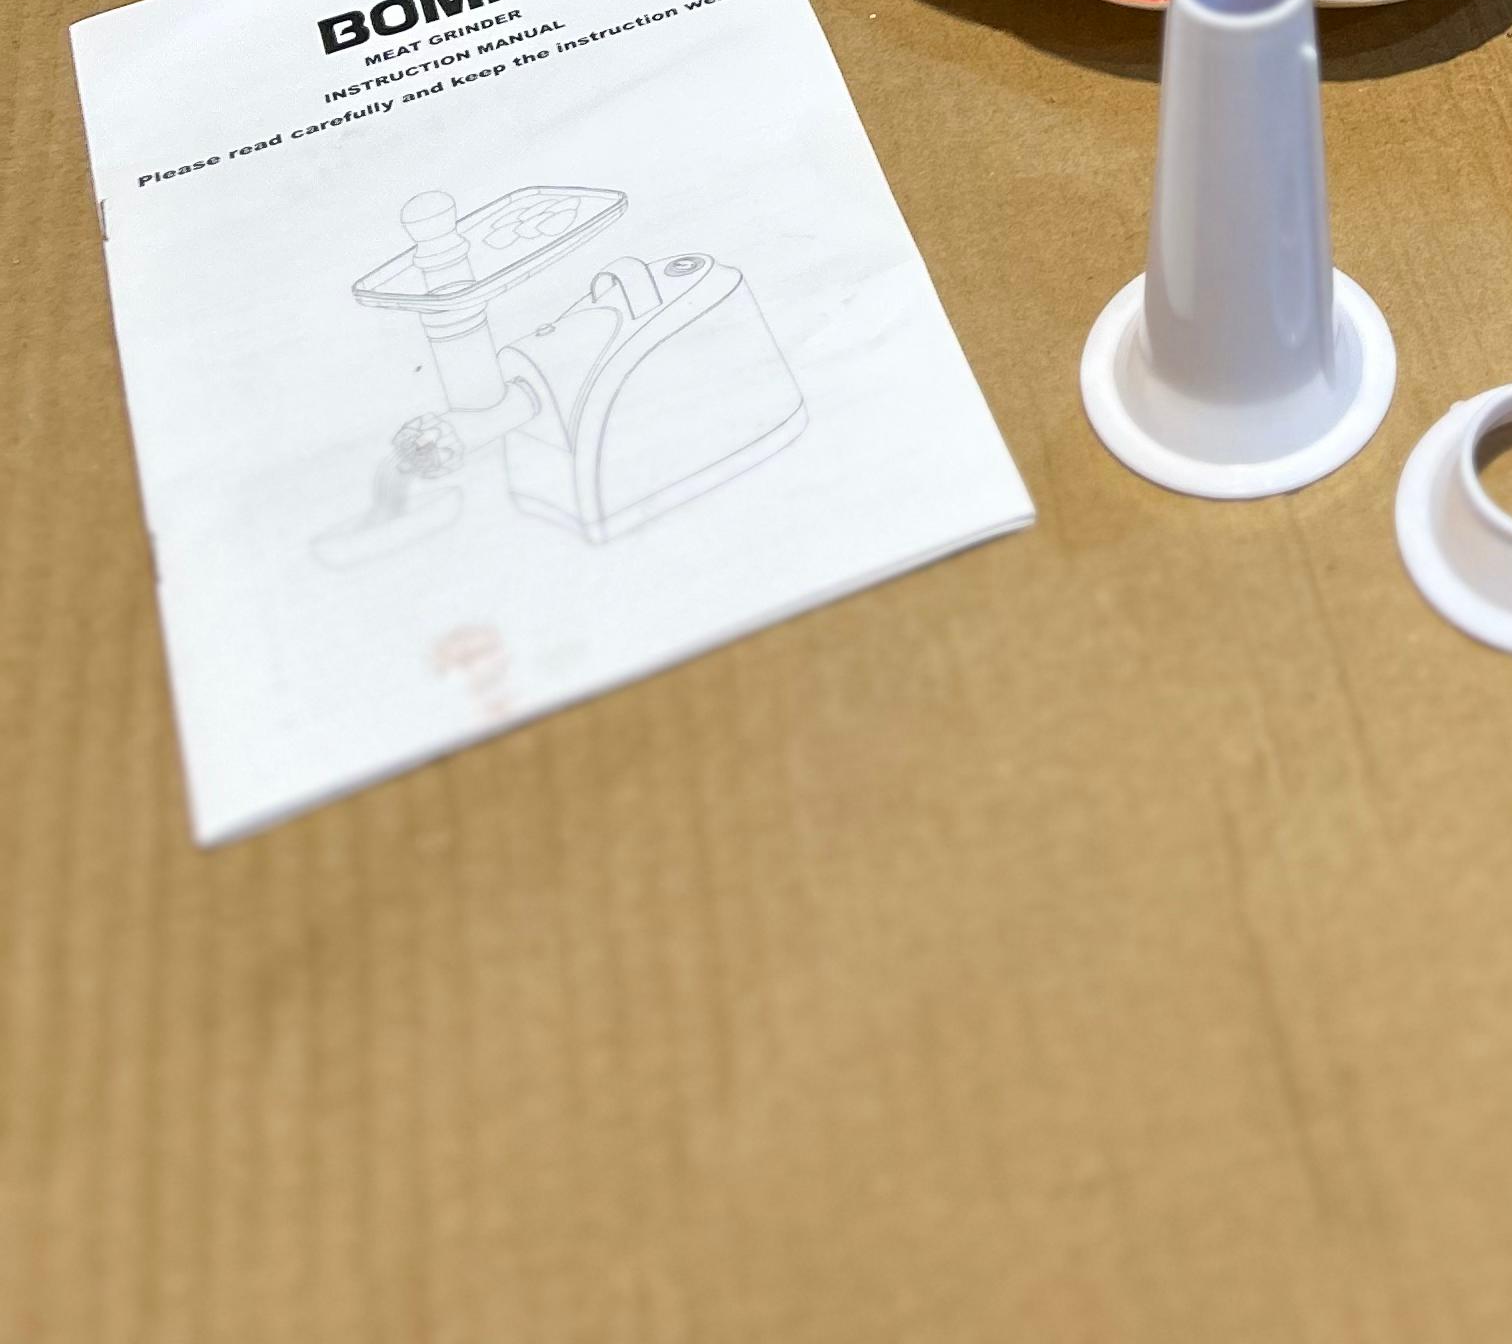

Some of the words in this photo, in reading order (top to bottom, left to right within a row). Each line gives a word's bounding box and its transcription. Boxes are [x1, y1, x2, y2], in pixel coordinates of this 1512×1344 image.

[324, 50, 471, 104] INSTRUCTION
[477, 19, 567, 57] MANUAL
[364, 41, 423, 68] MEAT
[428, 8, 523, 48] GRINDER
[138, 153, 222, 188] Please
[229, 133, 283, 161] read
[290, 97, 395, 141] carefully
[402, 79, 446, 104] and
[451, 62, 507, 91] keep
[513, 46, 551, 69] the
[555, 7, 679, 55] instruction
